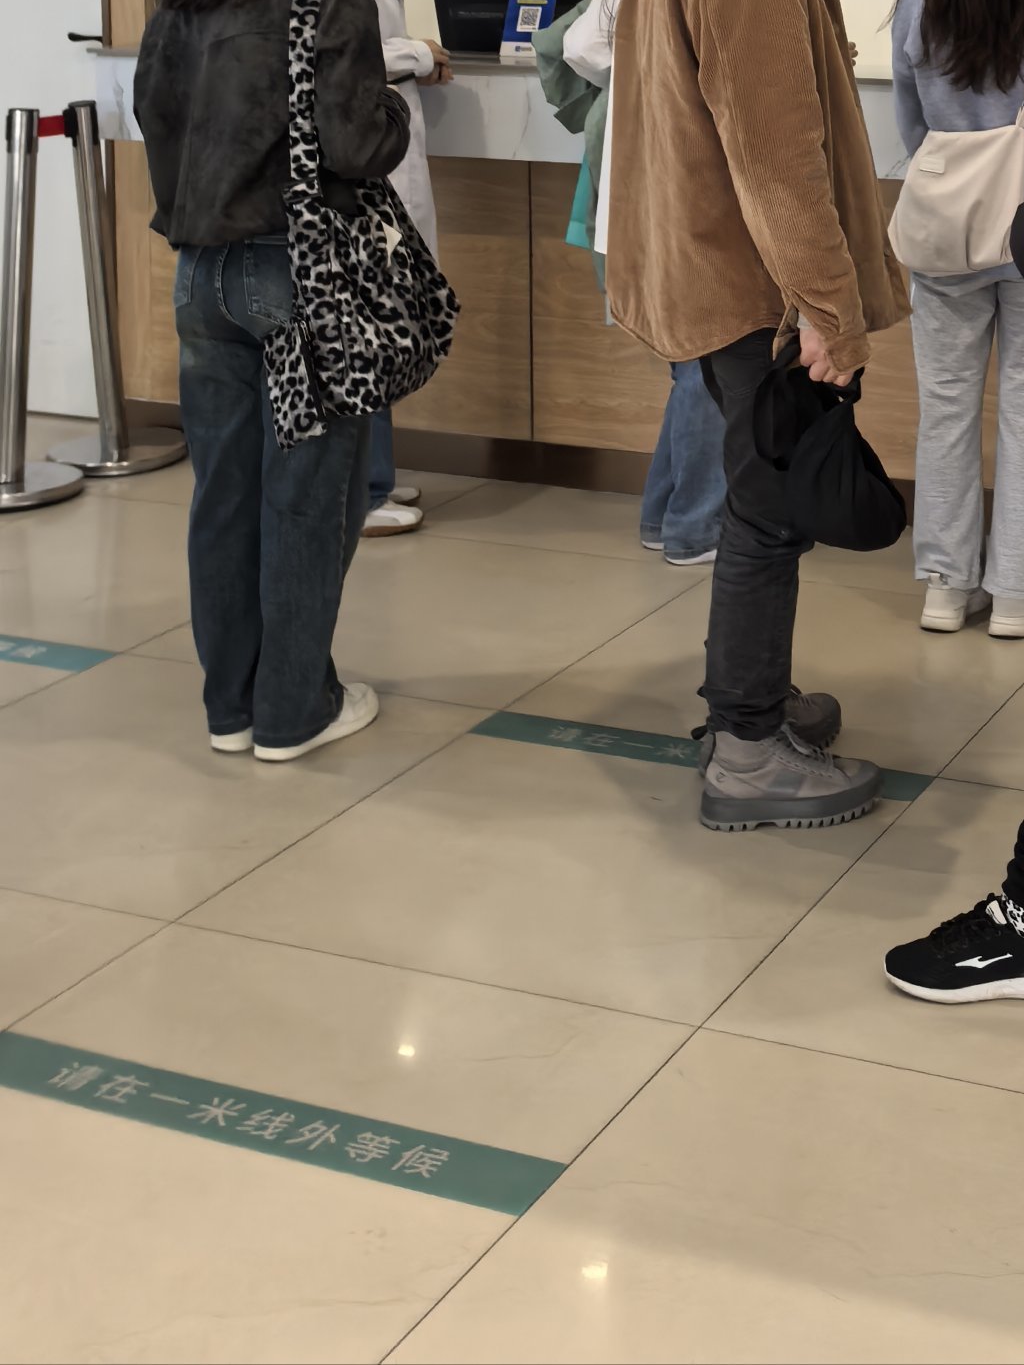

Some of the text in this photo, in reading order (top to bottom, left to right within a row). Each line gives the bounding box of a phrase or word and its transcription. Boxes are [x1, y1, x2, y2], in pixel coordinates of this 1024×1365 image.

[47, 1062, 451, 1178] 请在一米线外等候
